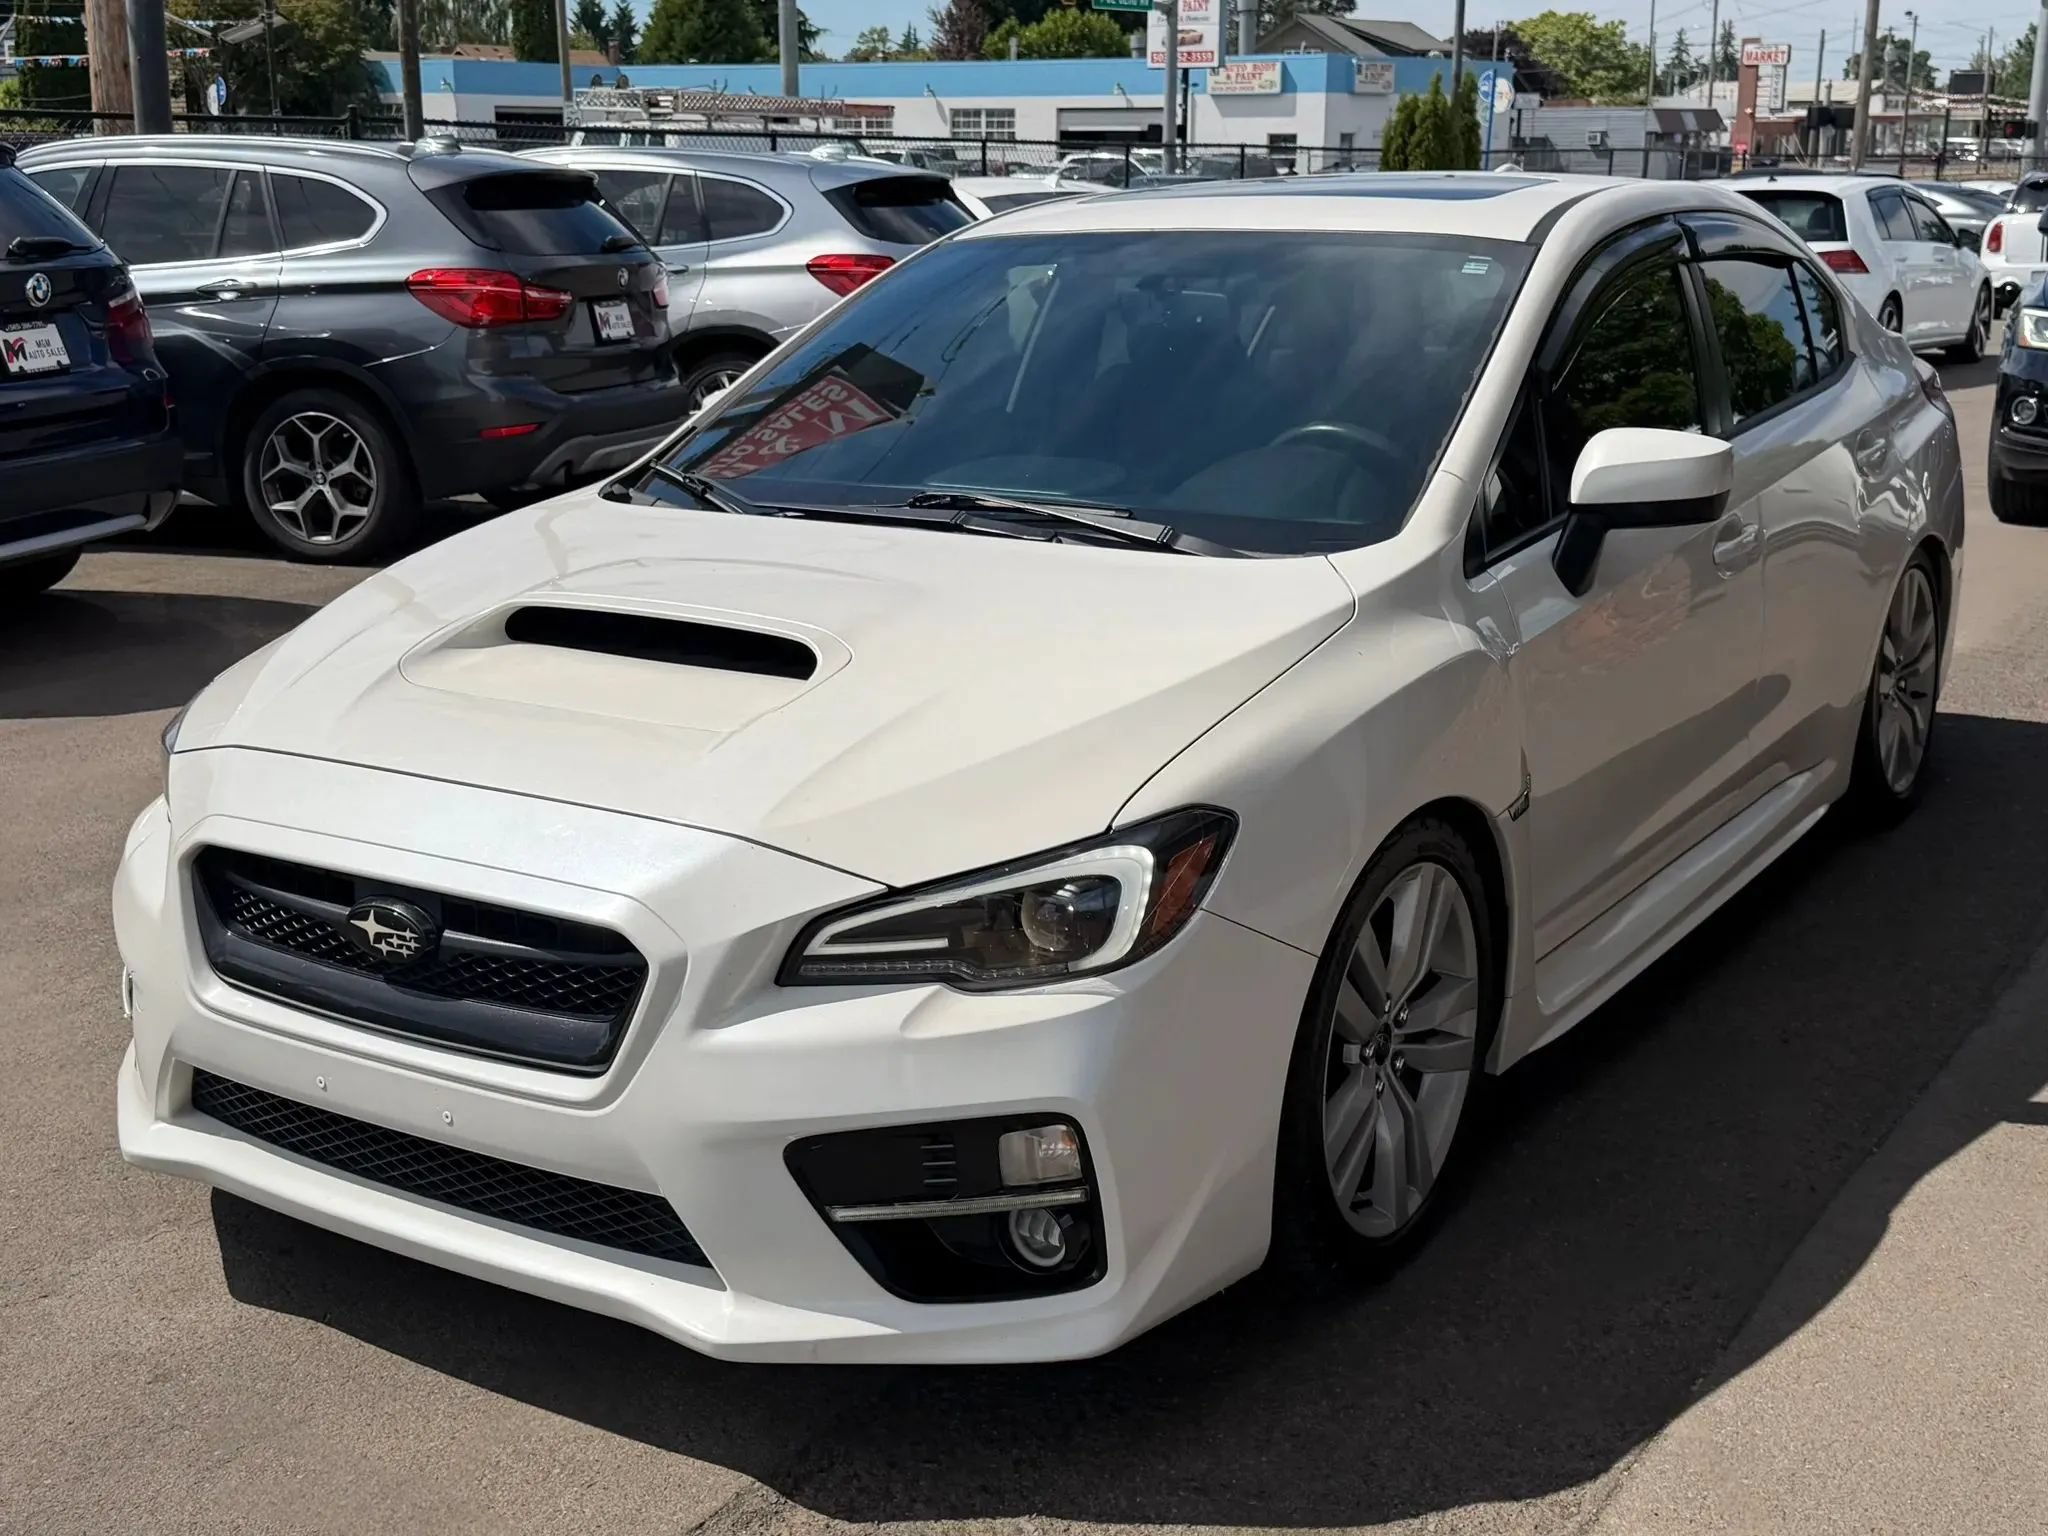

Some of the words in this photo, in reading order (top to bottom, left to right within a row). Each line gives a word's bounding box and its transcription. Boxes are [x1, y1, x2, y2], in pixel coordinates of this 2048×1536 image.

[1182, 0, 1209, 12] PAINT
[1746, 51, 1786, 63] MARKET
[28, 350, 45, 360] AUTO
[46, 347, 66, 357] SALES
